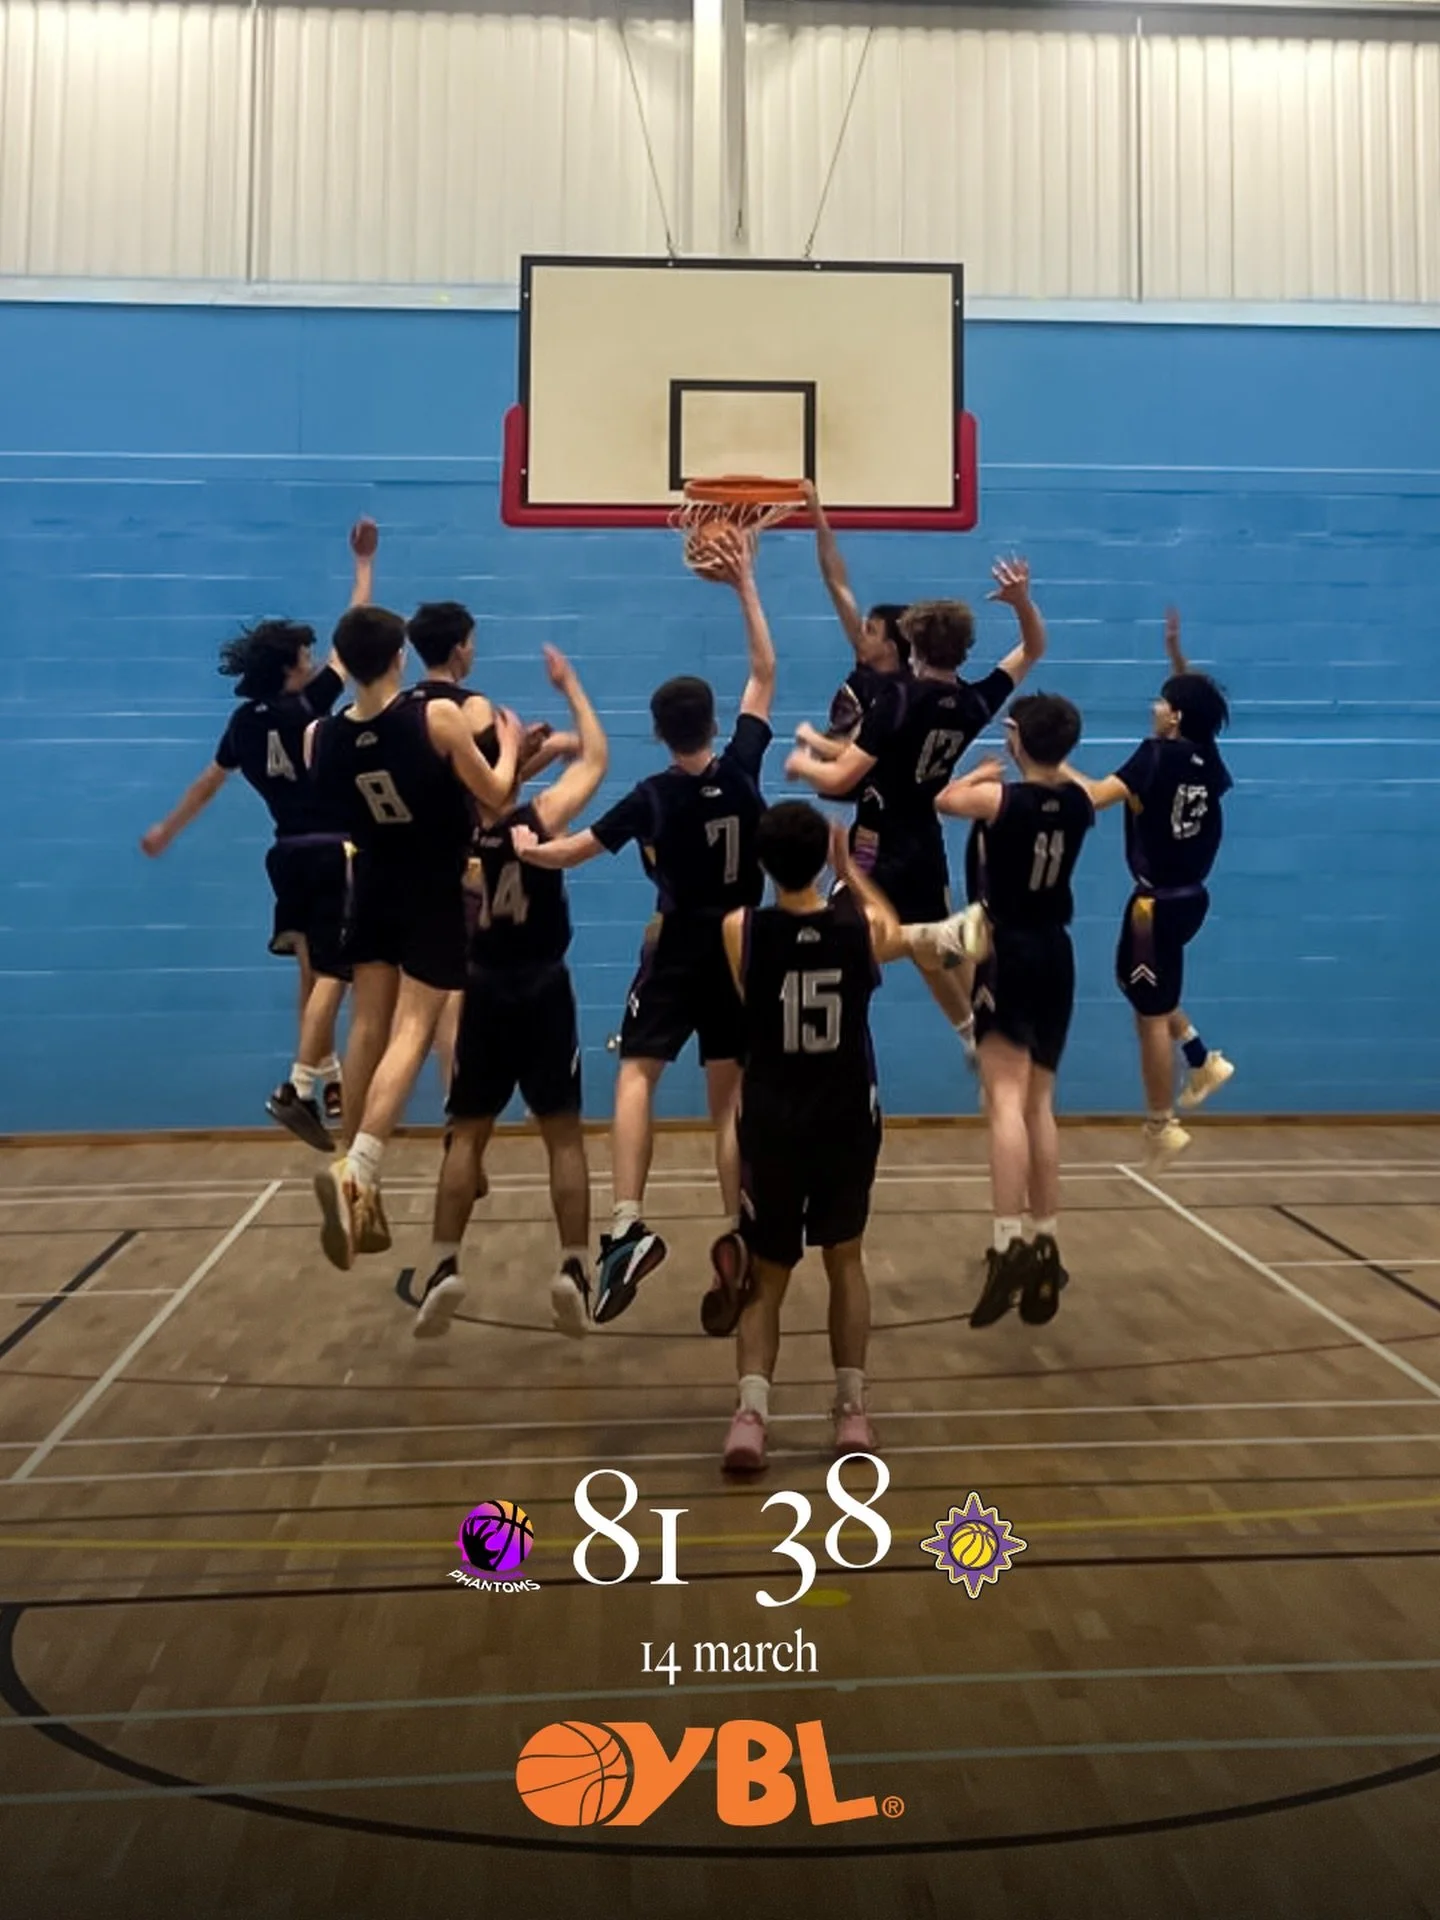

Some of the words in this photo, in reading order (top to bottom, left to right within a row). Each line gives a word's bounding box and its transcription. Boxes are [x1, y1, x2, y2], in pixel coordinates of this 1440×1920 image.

[267, 729, 297, 782] 4
[355, 769, 413, 824] 8
[705, 815, 740, 884] 7
[1028, 829, 1065, 891] 11
[780, 968, 842, 1053] 15
